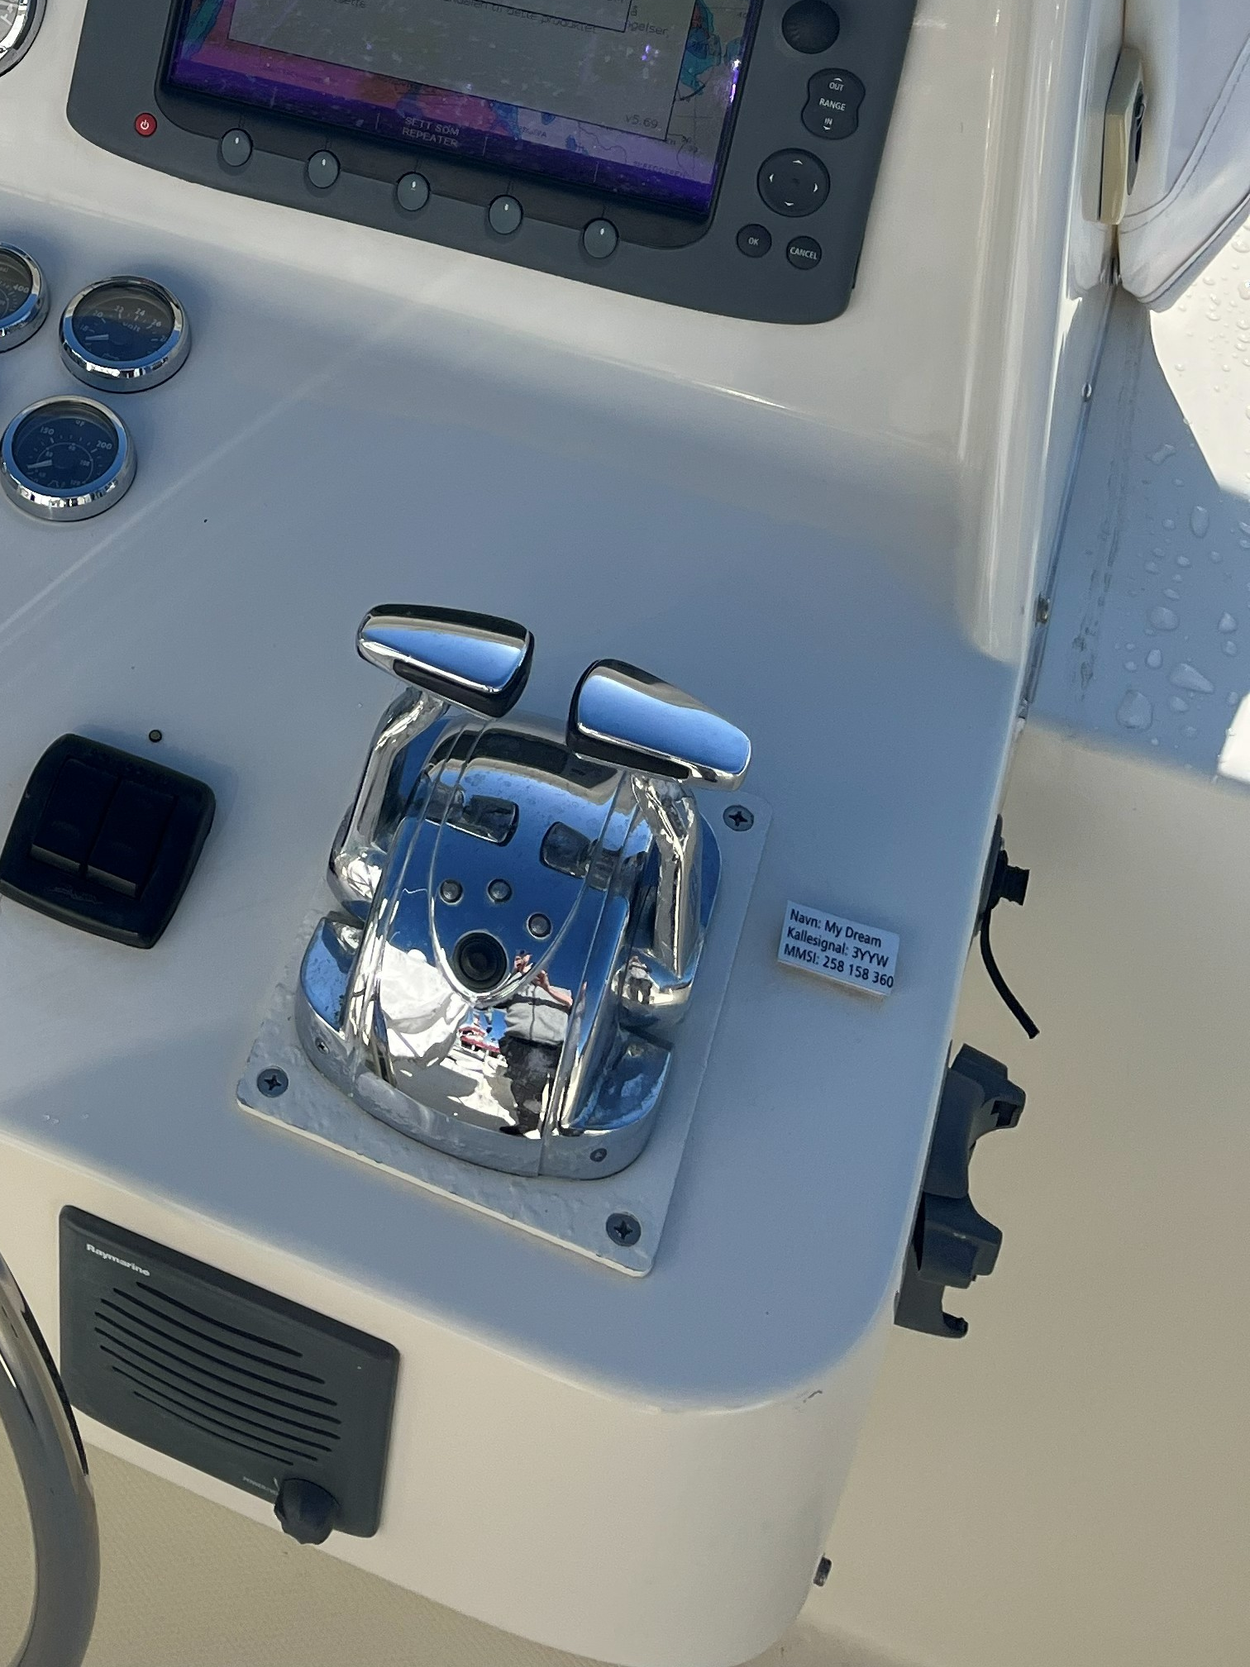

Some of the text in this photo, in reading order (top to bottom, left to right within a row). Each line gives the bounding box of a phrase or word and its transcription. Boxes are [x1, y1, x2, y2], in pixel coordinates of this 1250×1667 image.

[829, 82, 844, 91] OUT
[819, 98, 846, 111] RANGE
[405, 116, 460, 136] SETT SOM
[624, 112, 659, 129] v5.69
[825, 118, 832, 126] IN
[402, 126, 458, 148] REPEATER
[748, 237, 759, 245] OK
[790, 246, 818, 260] CANCEL
[13, 284, 29, 293] 400
[135, 308, 145, 316] 24
[122, 321, 141, 332] volt
[151, 319, 162, 327] 26
[40, 426, 54, 435] 150
[96, 440, 112, 450] 200
[790, 908, 881, 947] Navn: My Dream
[787, 926, 889, 967] Kallesignal: 3YYW
[784, 944, 894, 988] MMSI: 258 158 360
[86, 1243, 150, 1276] Raymarine
